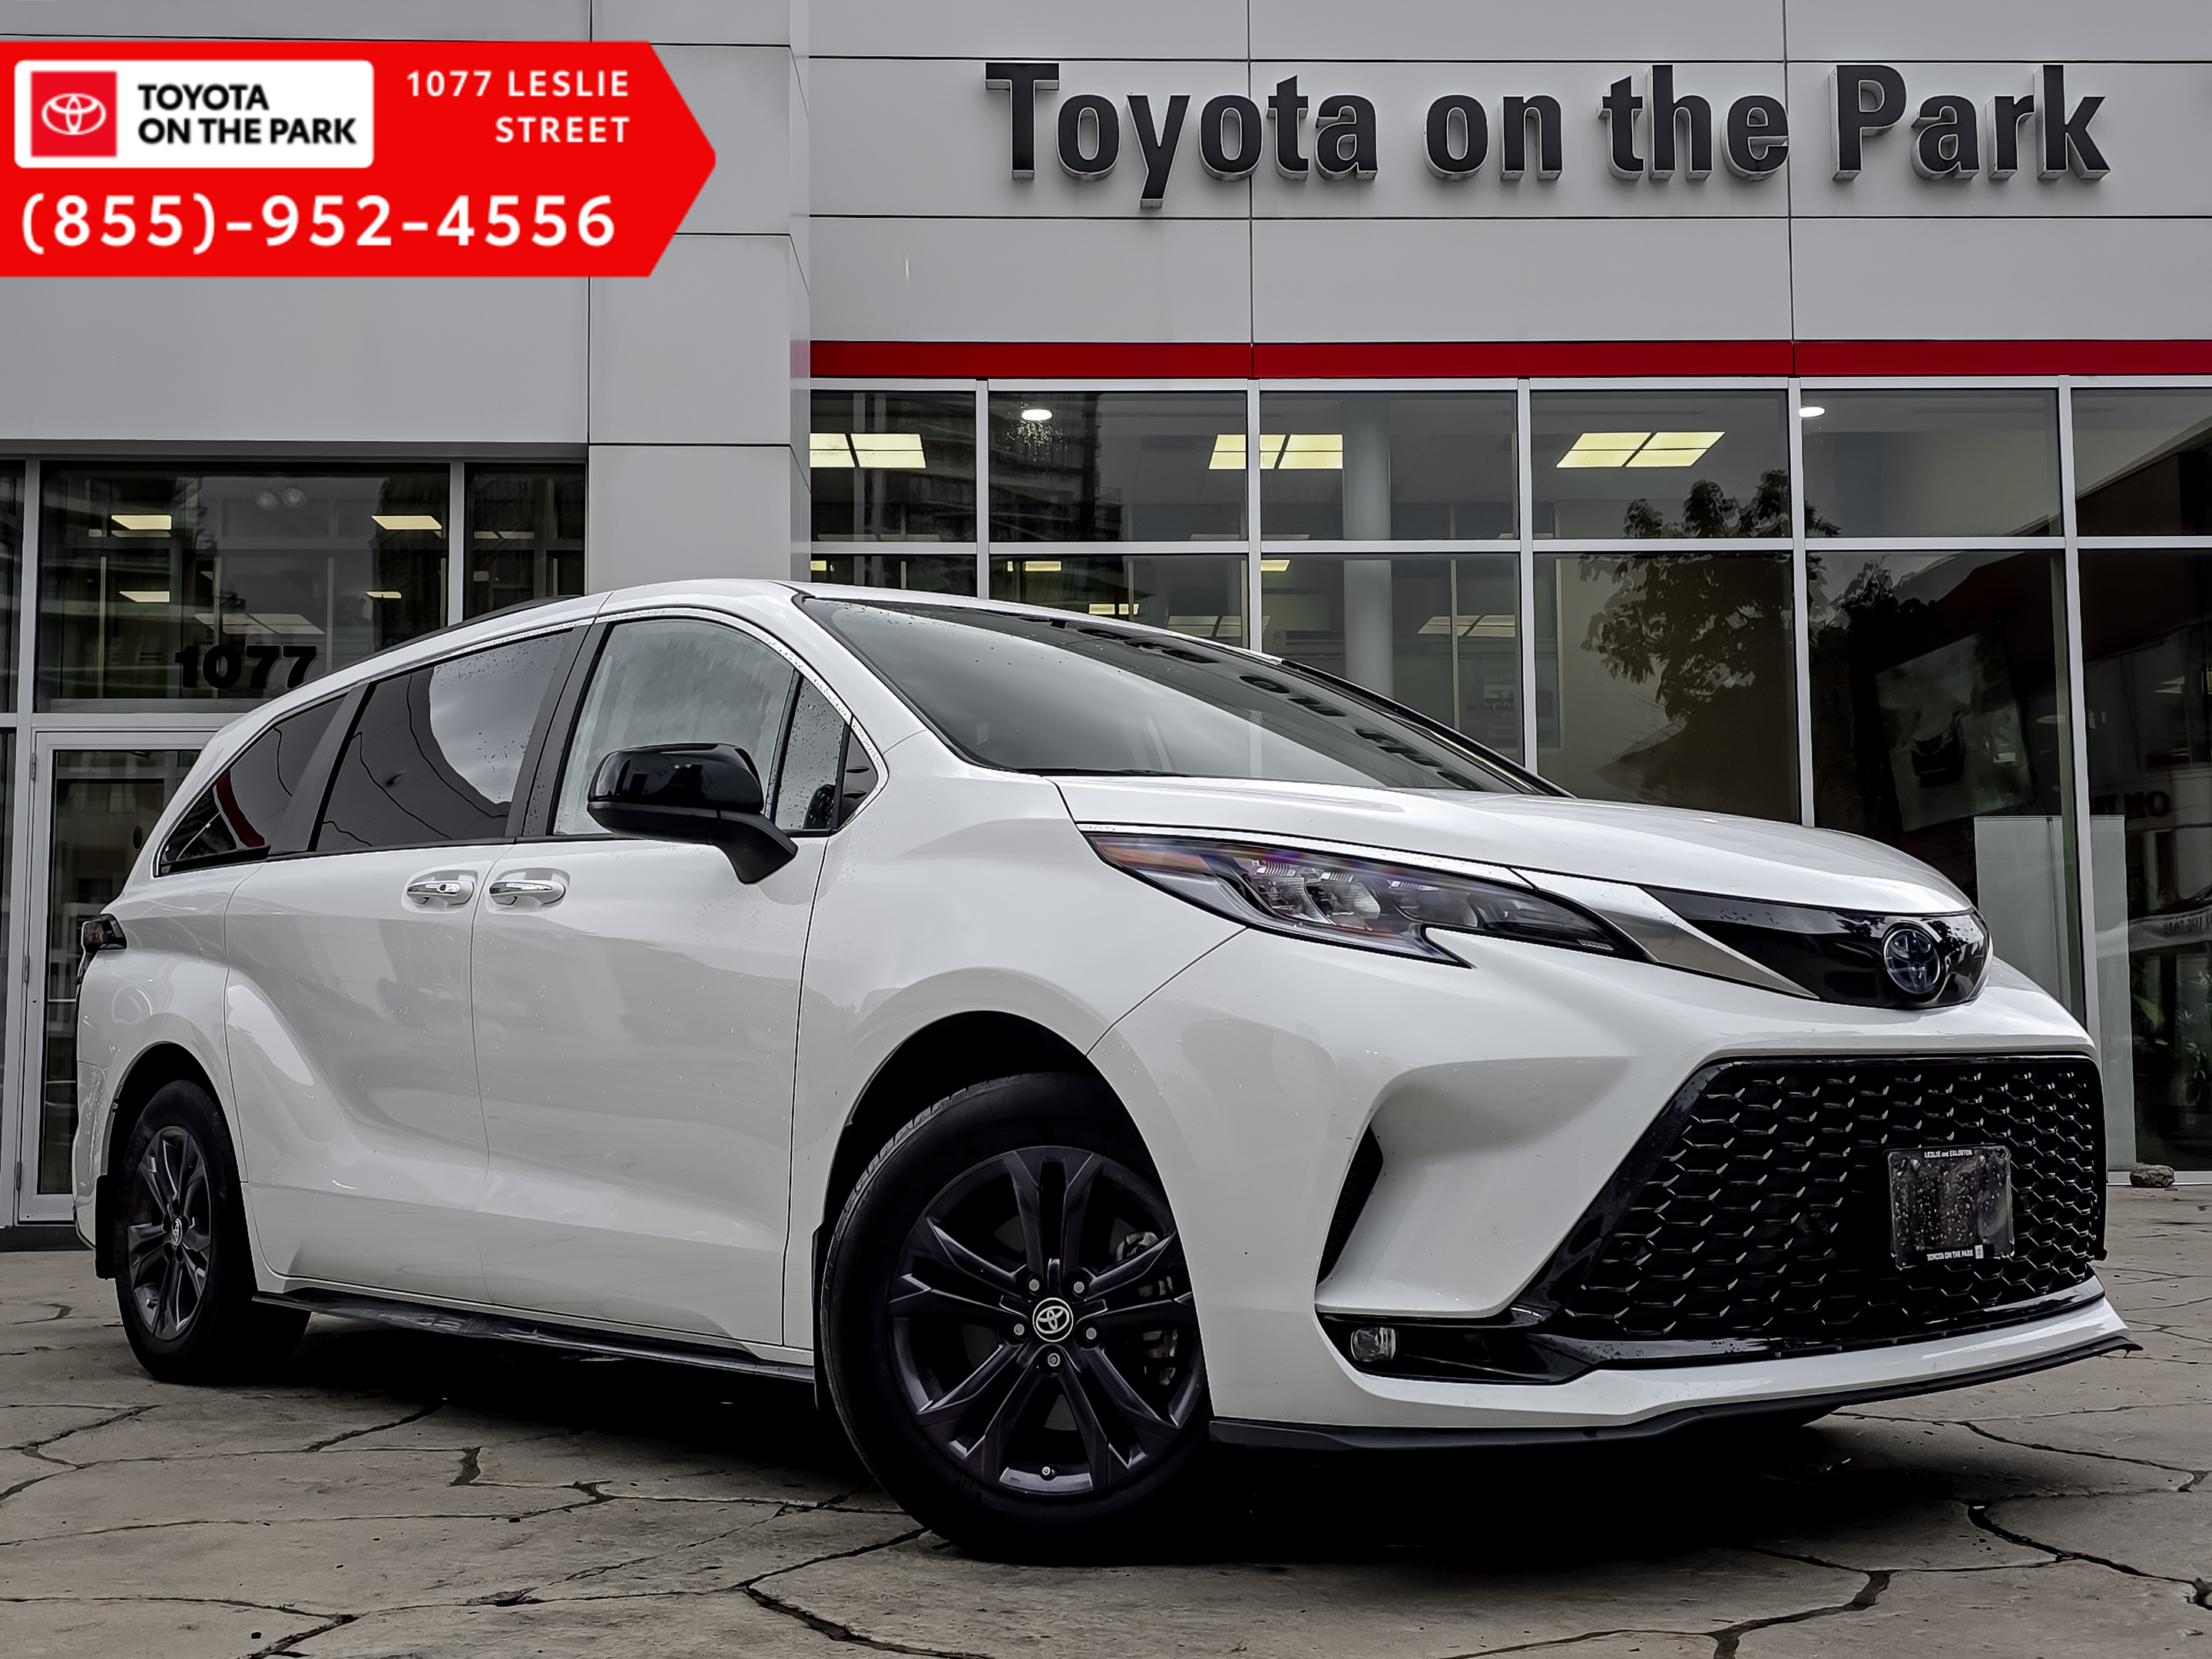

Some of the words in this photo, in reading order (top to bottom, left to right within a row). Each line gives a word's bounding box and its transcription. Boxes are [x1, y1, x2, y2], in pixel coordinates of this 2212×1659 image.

[985, 62, 1379, 208] Toyota
[1424, 94, 1562, 181] on
[1597, 65, 1789, 183] the
[1828, 65, 2110, 181] Park
[174, 644, 317, 689] 1077
